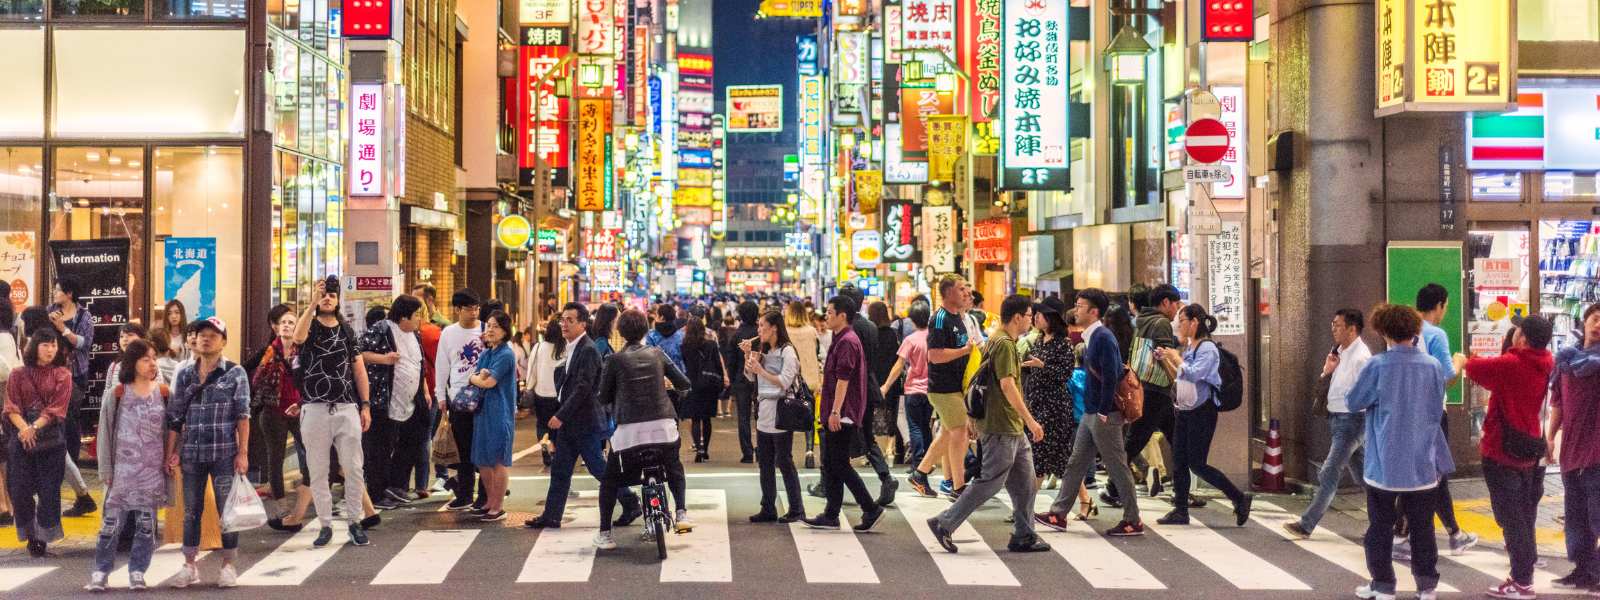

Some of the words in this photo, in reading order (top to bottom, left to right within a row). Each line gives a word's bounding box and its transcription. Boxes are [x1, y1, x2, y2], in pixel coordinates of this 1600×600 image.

[535, 10, 553, 20] 3F
[527, 27, 562, 45] 焼肉
[1467, 66, 1498, 91] 2F
[358, 93, 376, 186] 劇場通り
[1022, 168, 1049, 185] 2F
[1187, 169, 1228, 180] 自転車を除く
[60, 254, 120, 264] information
[173, 248, 207, 259] 北海道
[1221, 229, 1233, 316] 防犯カメラ作動中
[91, 288, 102, 296] 4F
[92, 315, 102, 323] 3F
[92, 344, 102, 352] 2F
